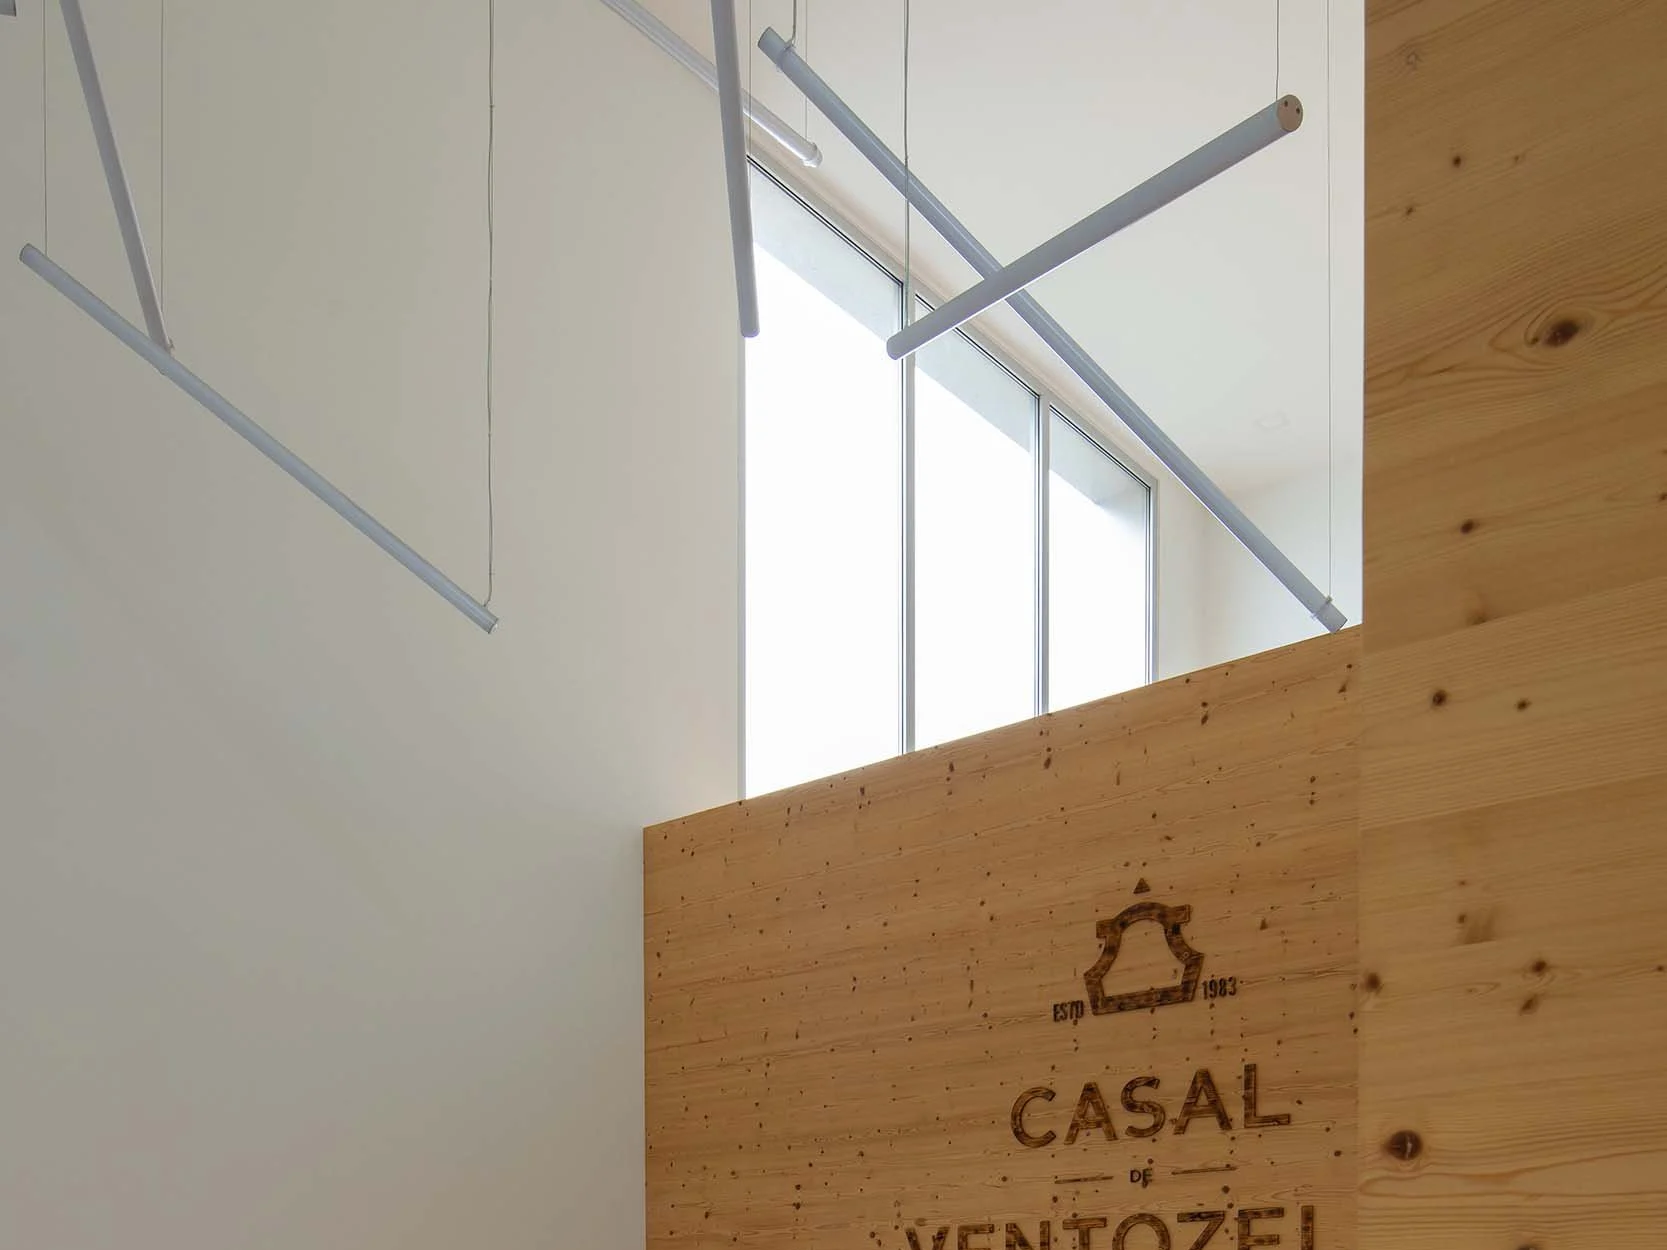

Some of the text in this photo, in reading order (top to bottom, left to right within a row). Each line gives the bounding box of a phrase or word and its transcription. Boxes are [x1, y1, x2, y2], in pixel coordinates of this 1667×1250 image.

[1202, 976, 1238, 1000] 1983
[1011, 1063, 1292, 1148] CASAL
[1129, 1168, 1153, 1184] DE
